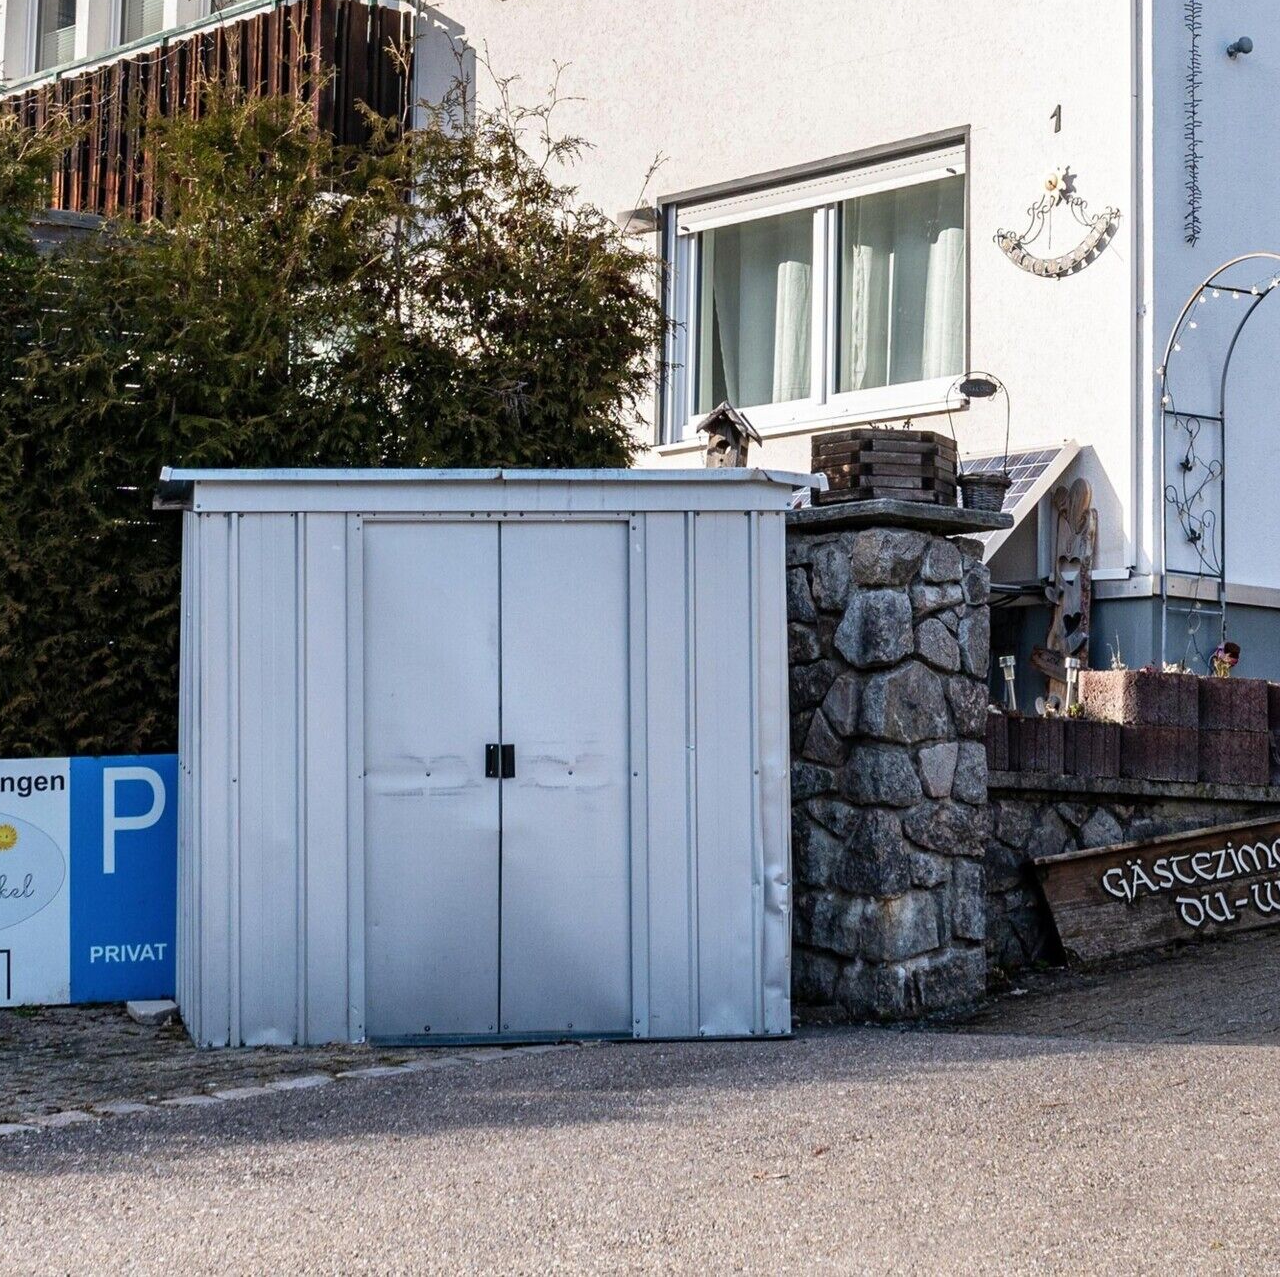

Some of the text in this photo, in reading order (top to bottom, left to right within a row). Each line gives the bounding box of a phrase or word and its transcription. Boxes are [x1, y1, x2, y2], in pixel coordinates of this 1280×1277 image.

[1050, 104, 1061, 133] 1
[102, 766, 166, 874] P
[90, 943, 168, 965] PRIVAT
